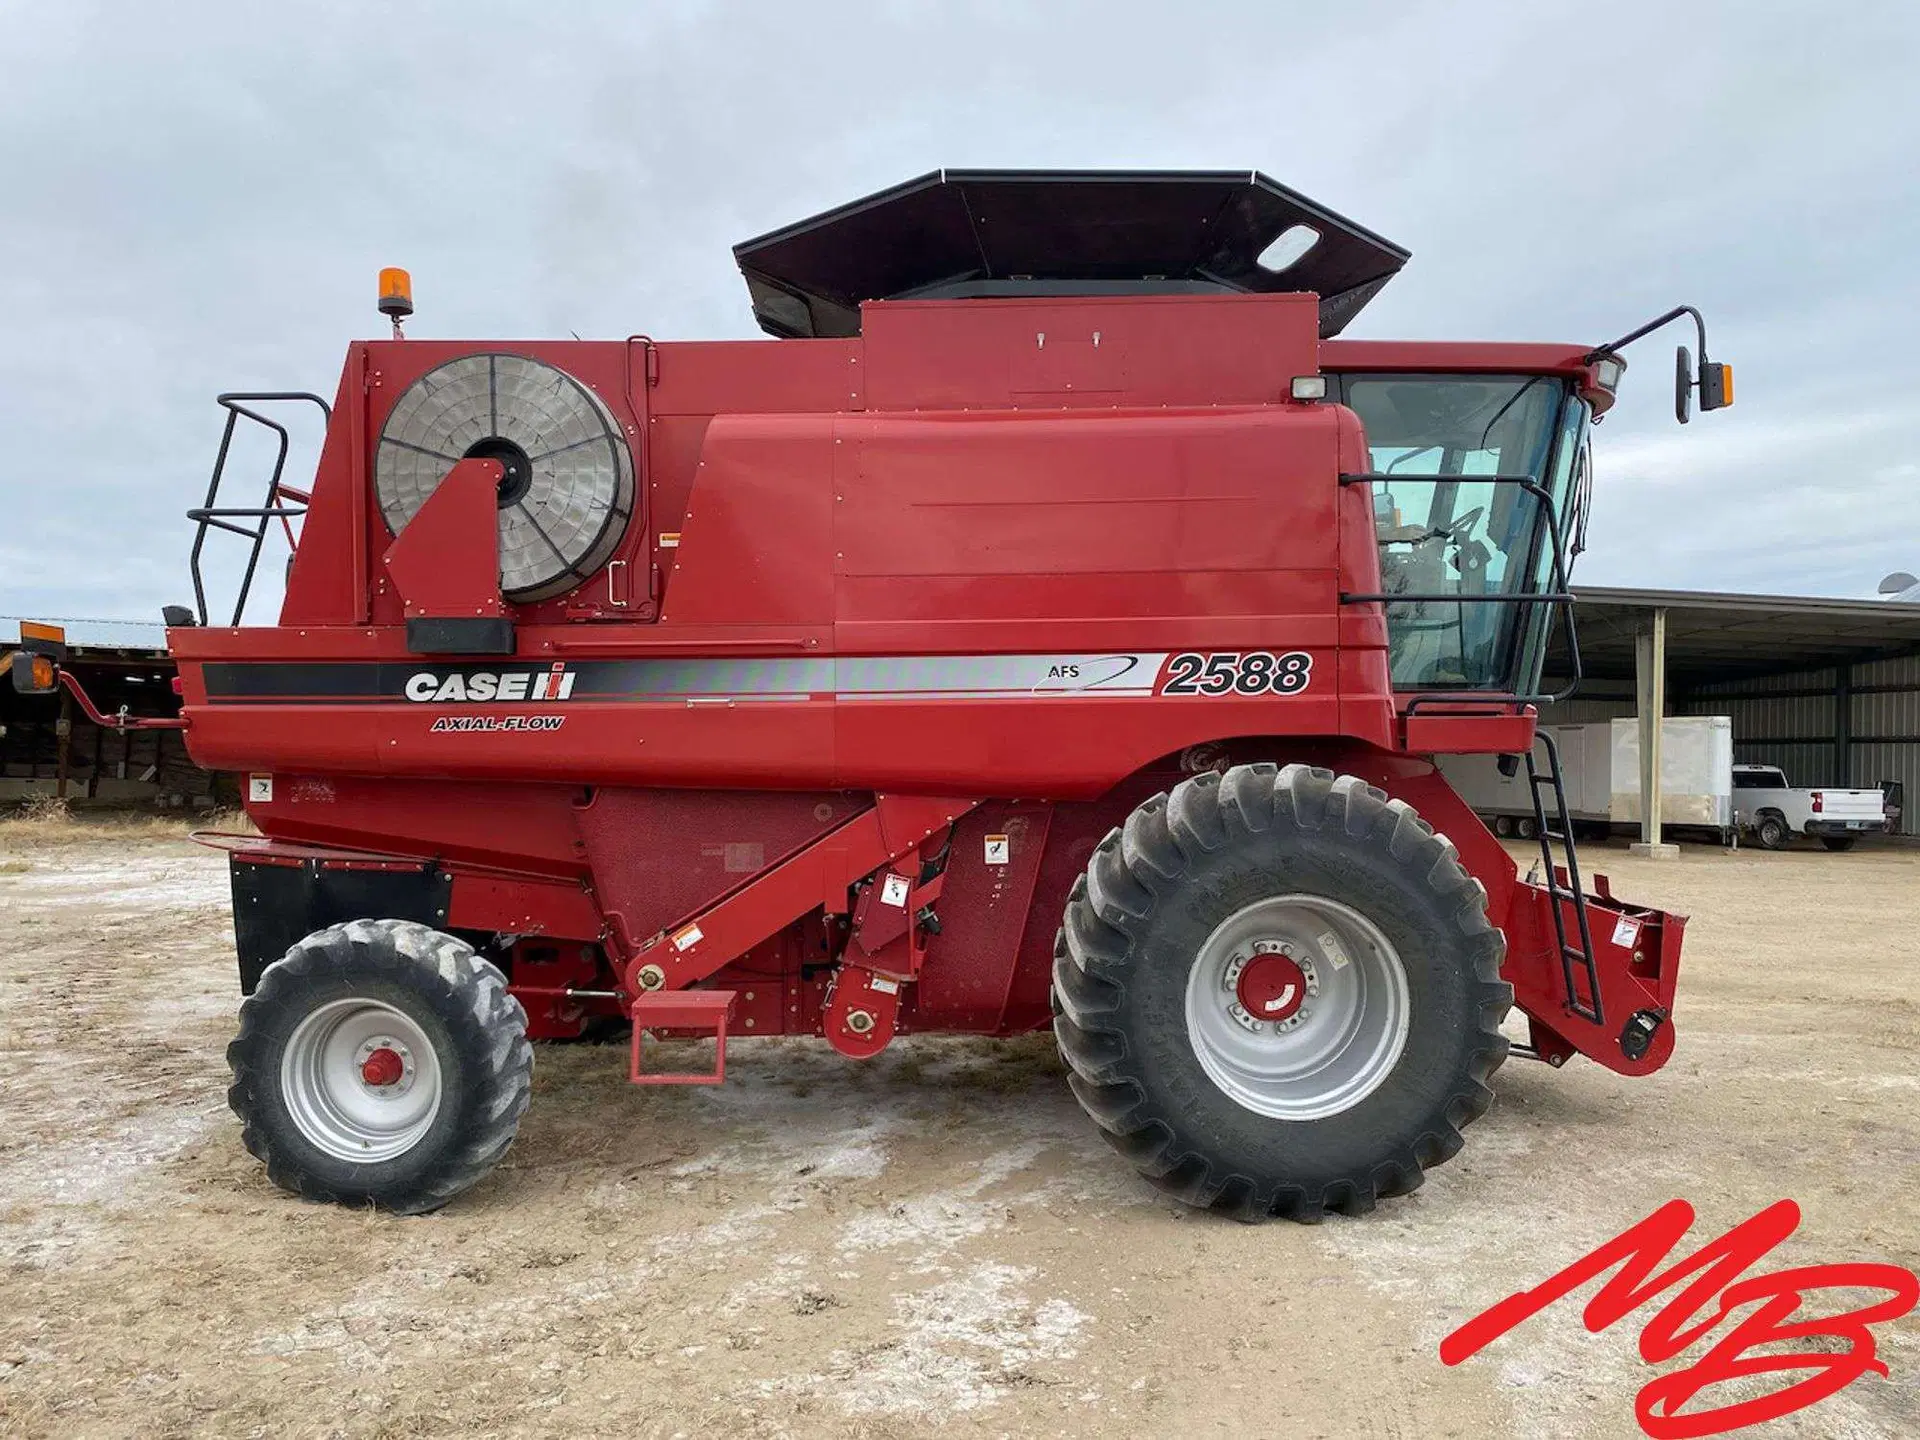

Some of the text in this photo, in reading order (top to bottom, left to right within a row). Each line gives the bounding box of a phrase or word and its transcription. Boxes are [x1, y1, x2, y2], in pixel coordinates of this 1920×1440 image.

[1048, 665, 1079, 678] AFS
[1162, 651, 1312, 696] 2588
[405, 672, 530, 701] CASE
[431, 715, 565, 732] AXIAL-FLOW
